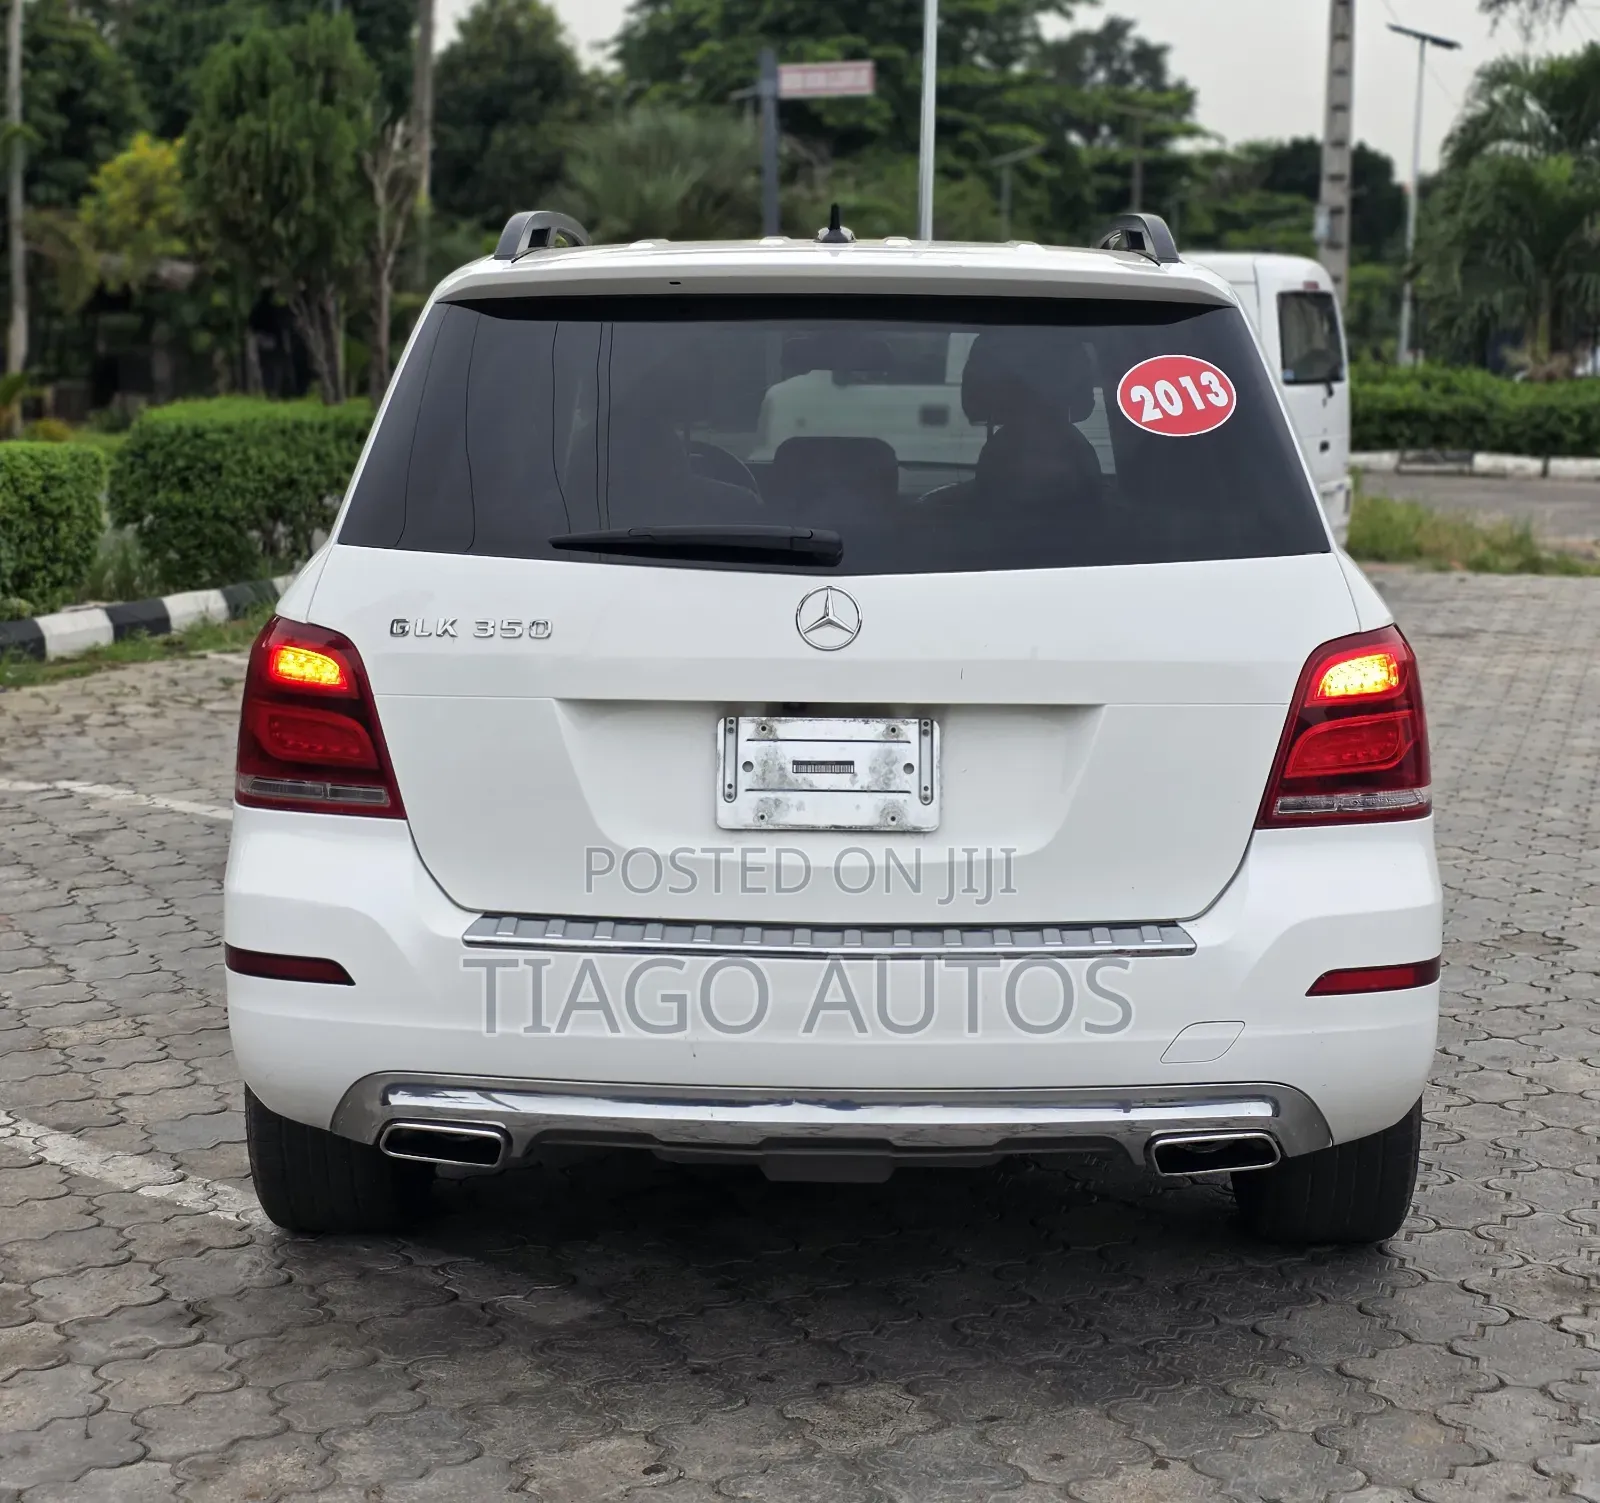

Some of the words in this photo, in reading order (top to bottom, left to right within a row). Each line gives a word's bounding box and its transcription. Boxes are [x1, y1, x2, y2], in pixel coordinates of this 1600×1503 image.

[1130, 371, 1229, 423] 2013
[390, 618, 458, 638] GLK
[473, 618, 553, 639] 350
